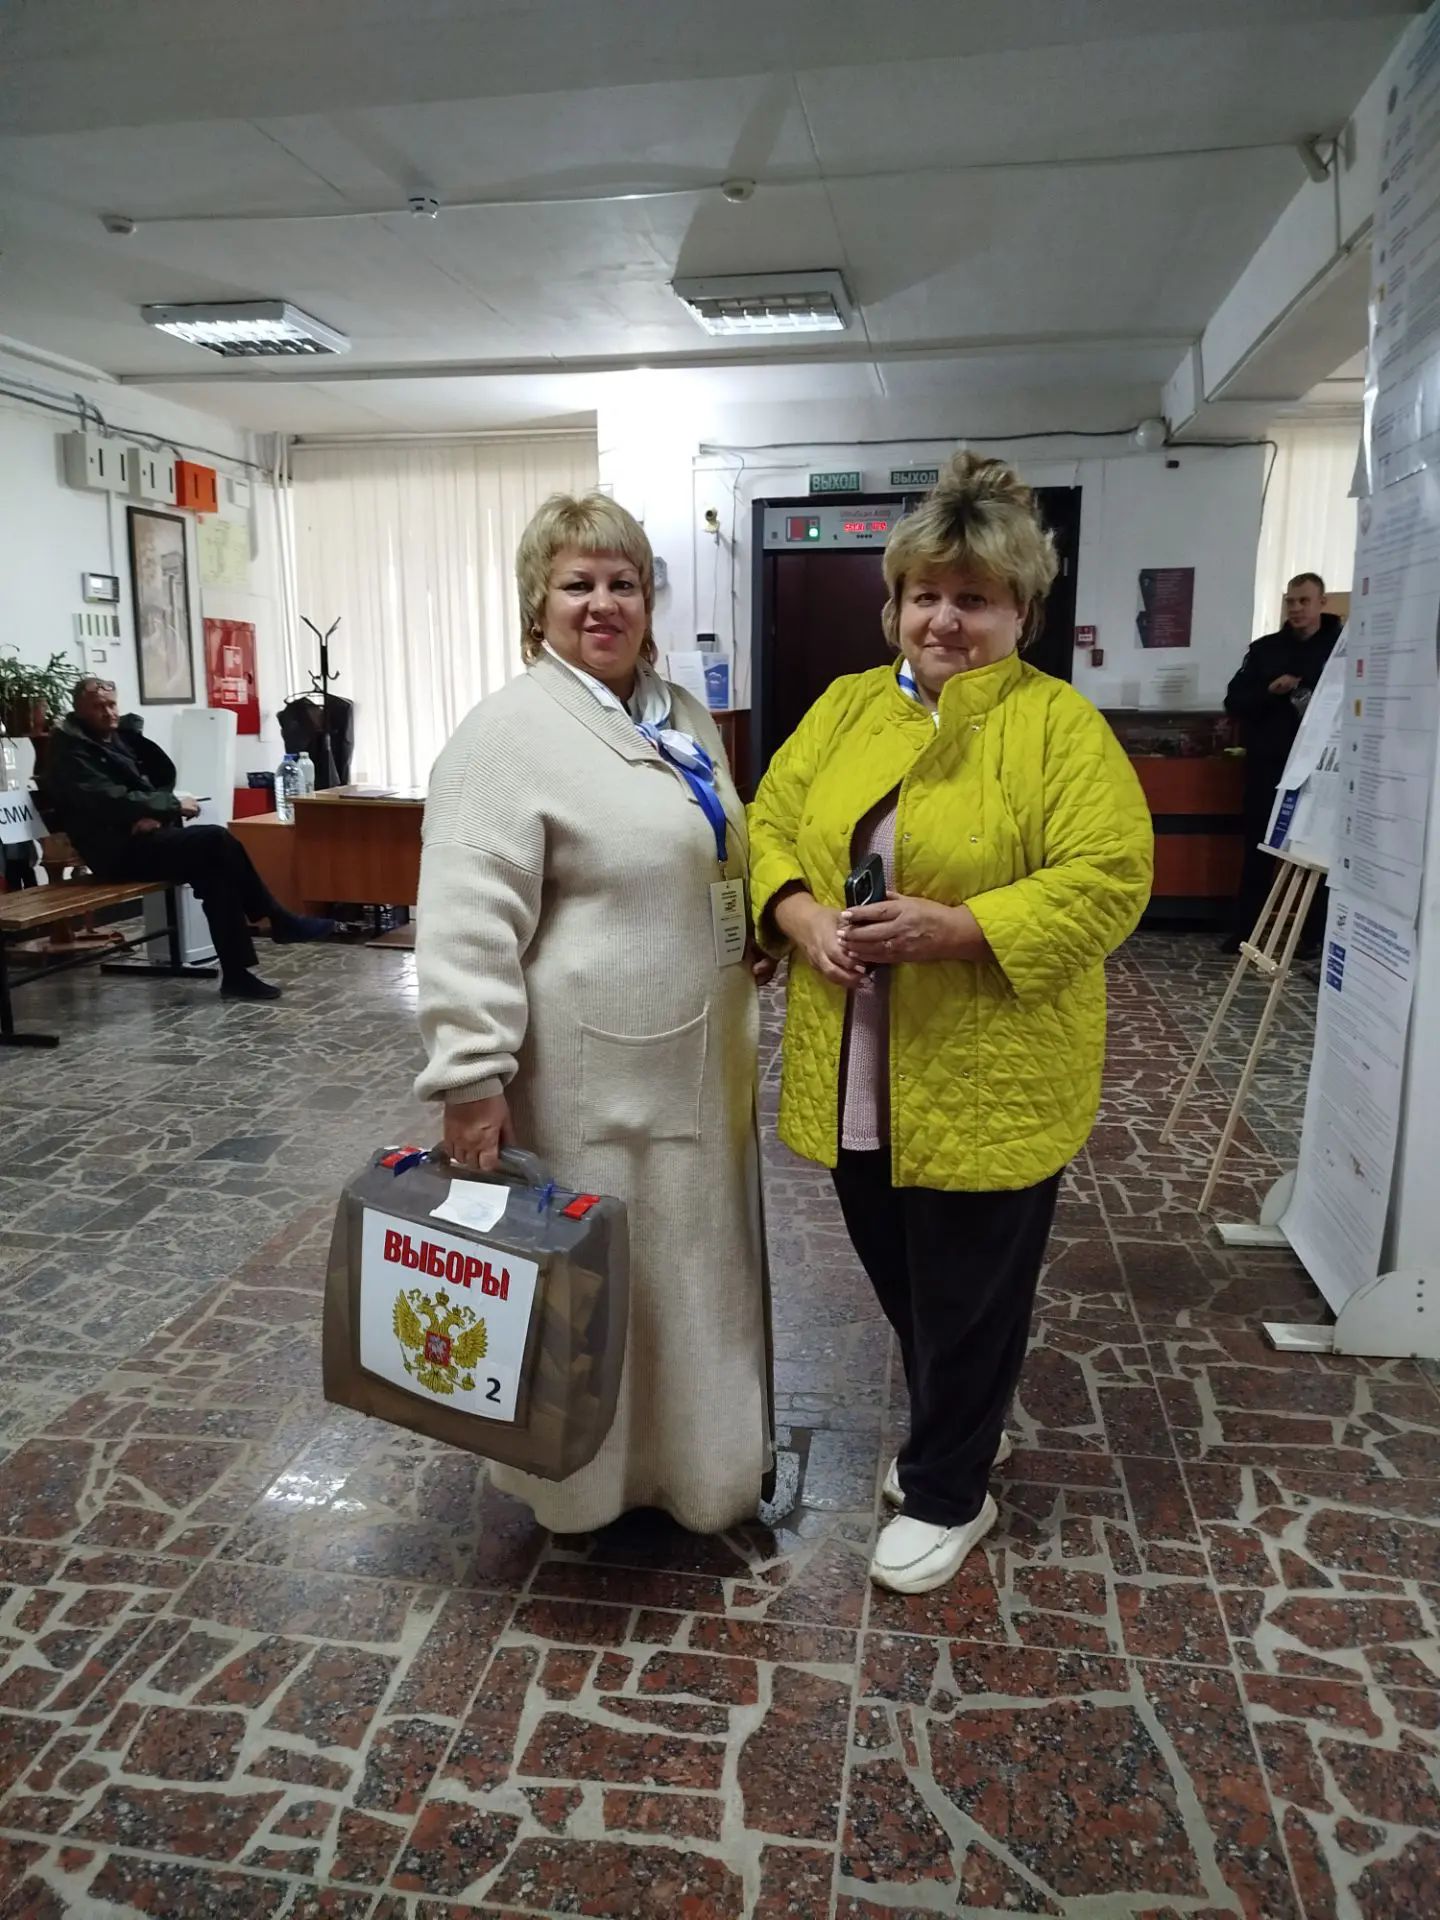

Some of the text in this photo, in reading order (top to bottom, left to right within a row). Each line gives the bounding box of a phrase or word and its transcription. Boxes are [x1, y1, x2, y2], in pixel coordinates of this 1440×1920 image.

[812, 474, 858, 490] ВЫХОД
[892, 472, 937, 484] ВЫХОД
[384, 1229, 510, 1301] ВЫБОРЫ
[486, 1377, 501, 1403] 2
